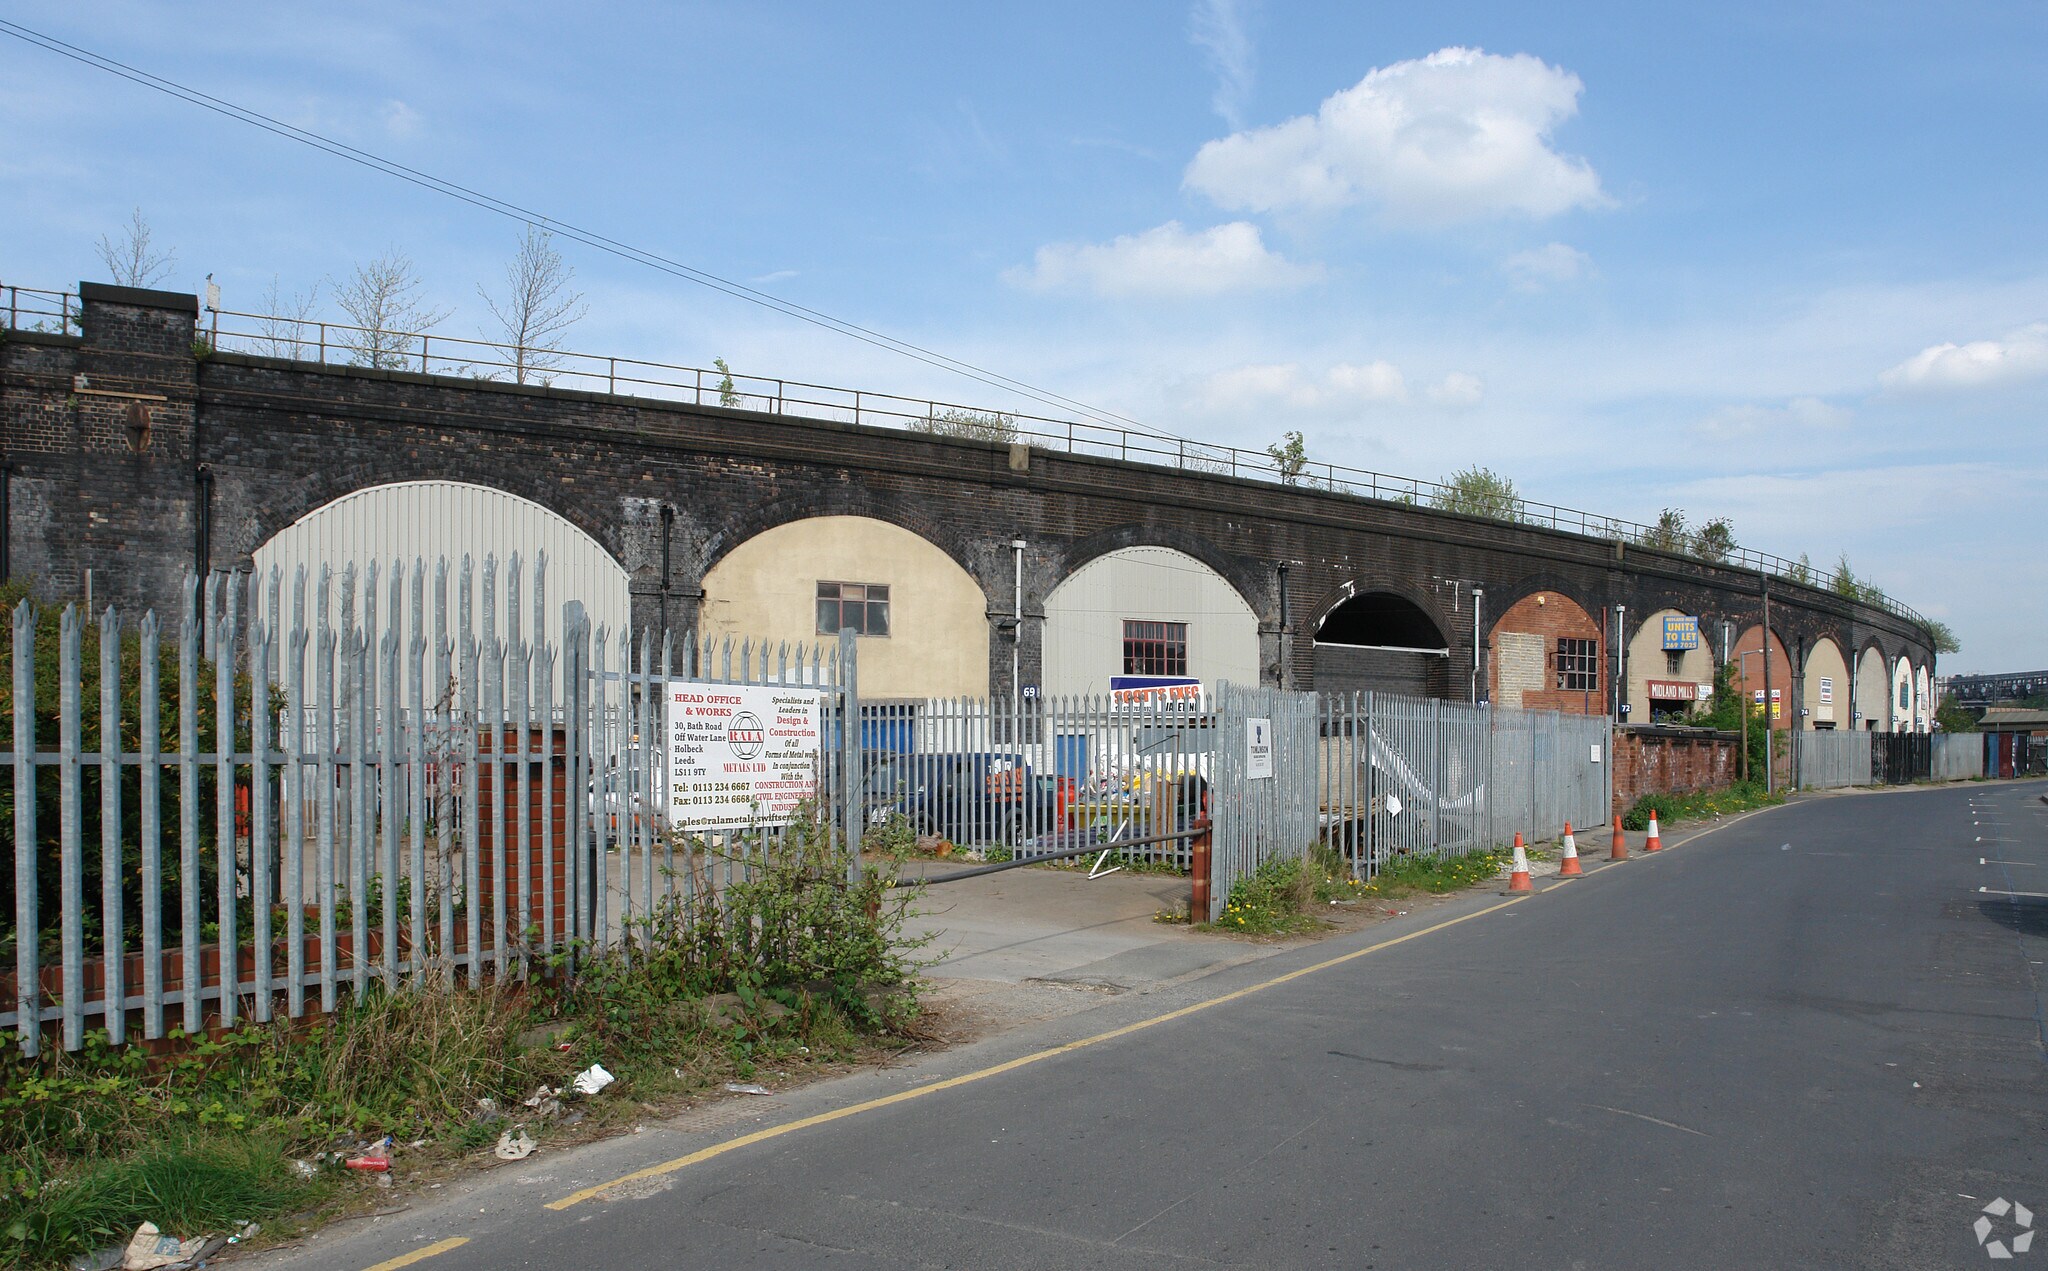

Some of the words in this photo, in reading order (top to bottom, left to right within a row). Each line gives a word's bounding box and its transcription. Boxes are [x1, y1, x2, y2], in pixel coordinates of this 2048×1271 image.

[1668, 623, 1694, 631] UNITS
[1023, 688, 1035, 696] 69
[1651, 684, 1676, 698] MIDLAND
[1678, 685, 1693, 698] MILLS
[674, 694, 704, 702] HEAD
[707, 695, 742, 704] OFFICE
[772, 696, 802, 705] Specialists
[686, 707, 693, 715] &
[696, 707, 732, 716] WORKS
[776, 716, 801, 726] Design
[675, 722, 686, 731] 30,
[687, 722, 703, 730] Bath
[705, 722, 722, 730] Road
[729, 731, 762, 741] RALA
[769, 728, 816, 736] Construction
[675, 733, 686, 741] Off
[784, 739, 791, 748] Of
[674, 744, 703, 753] Holbeck
[782, 750, 788, 758] of
[789, 750, 804, 758] Metal
[674, 756, 695, 764] Leeds
[723, 763, 750, 772] METALS
[753, 763, 766, 772] LTD
[780, 762, 810, 771] conjunction
[673, 783, 688, 792] Tel:
[693, 783, 712, 791] 0113
[715, 783, 729, 791] 234
[731, 782, 750, 790] 6667
[755, 781, 804, 789] CONSTRUCTION
[673, 796, 691, 805] Fax:
[693, 796, 713, 805] 0113
[715, 795, 730, 804] 234
[731, 794, 750, 803] 6668
